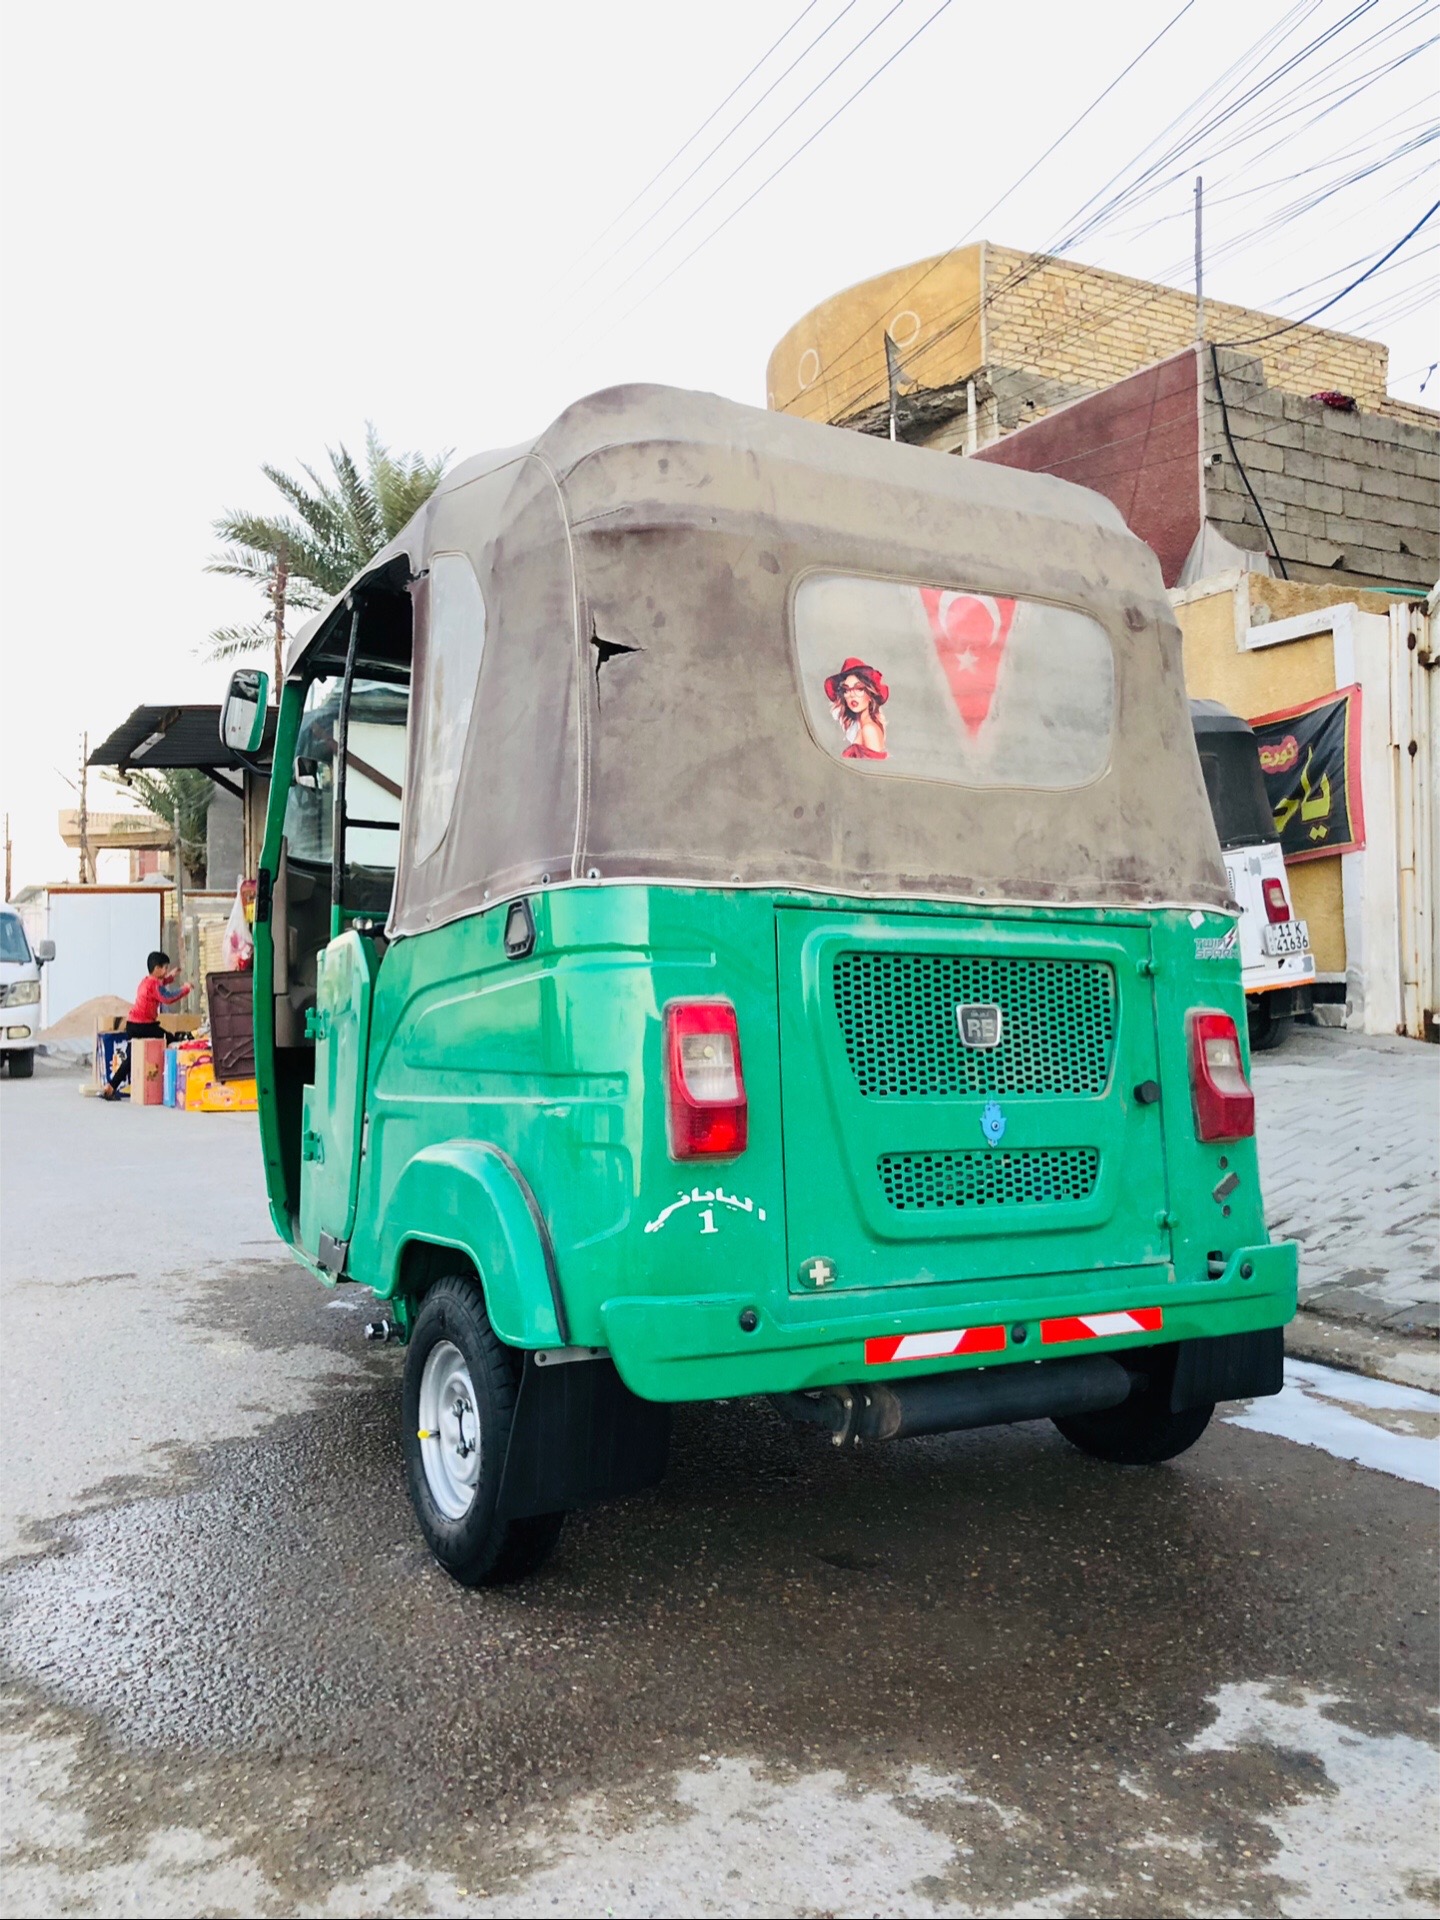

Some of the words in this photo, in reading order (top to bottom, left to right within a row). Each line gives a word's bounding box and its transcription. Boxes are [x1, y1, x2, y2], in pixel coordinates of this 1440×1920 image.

[1278, 923, 1292, 938] 11
[1295, 922, 1303, 935] K
[1194, 938, 1227, 949] TWIN
[1277, 936, 1309, 952] 41636
[966, 1018, 995, 1038] RE
